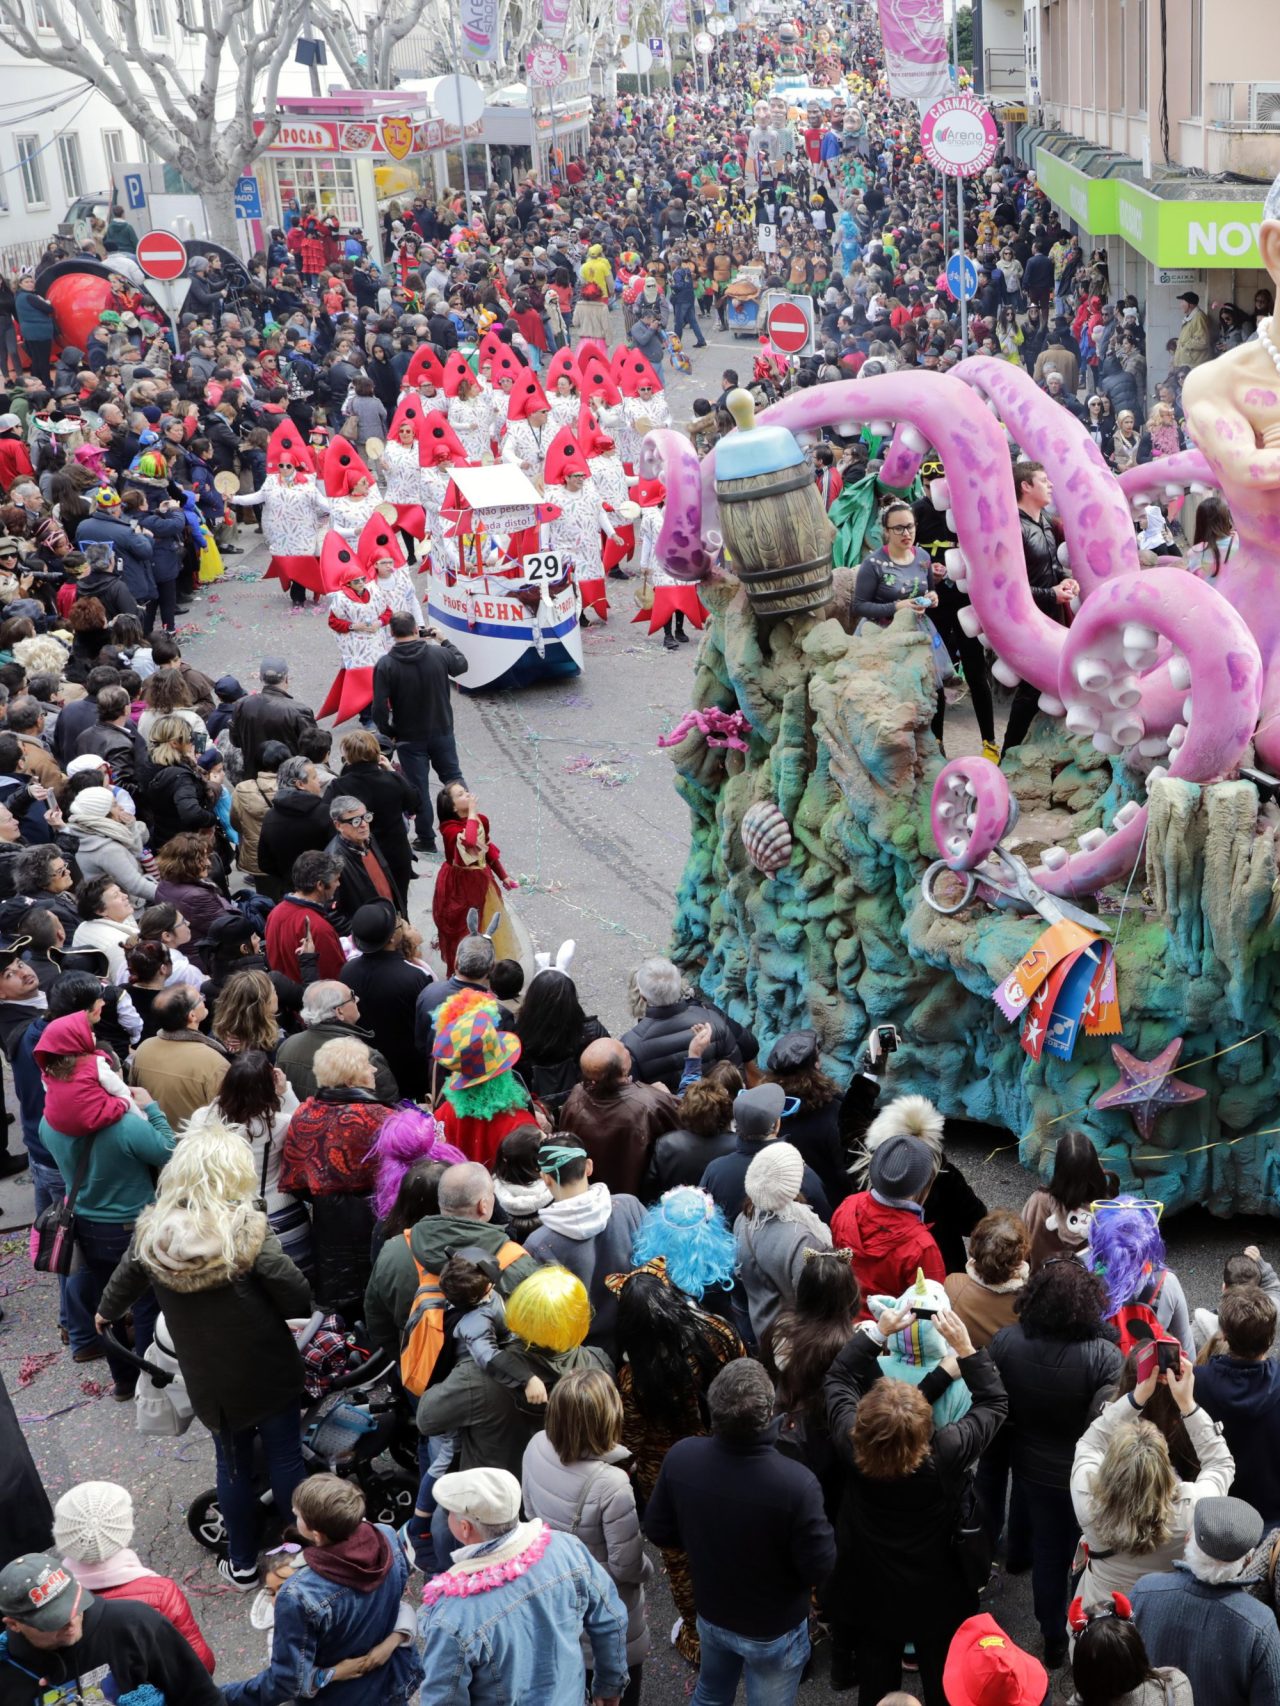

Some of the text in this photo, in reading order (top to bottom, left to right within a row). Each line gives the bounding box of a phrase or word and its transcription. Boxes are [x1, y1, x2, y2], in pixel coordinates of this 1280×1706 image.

[467, 0, 483, 32] Are
[929, 97, 988, 120] CARNAVAL
[277, 127, 322, 145] IPOCAS
[947, 130, 983, 141] Arena
[923, 143, 996, 175] TORRES VEDRAS
[128, 177, 140, 206] P
[764, 226, 772, 237] 9
[1188, 222, 1262, 257] NO
[478, 504, 530, 517] Não pescas
[505, 518, 530, 529] disto!
[527, 555, 559, 581] 29
[474, 601, 524, 621] AEHN
